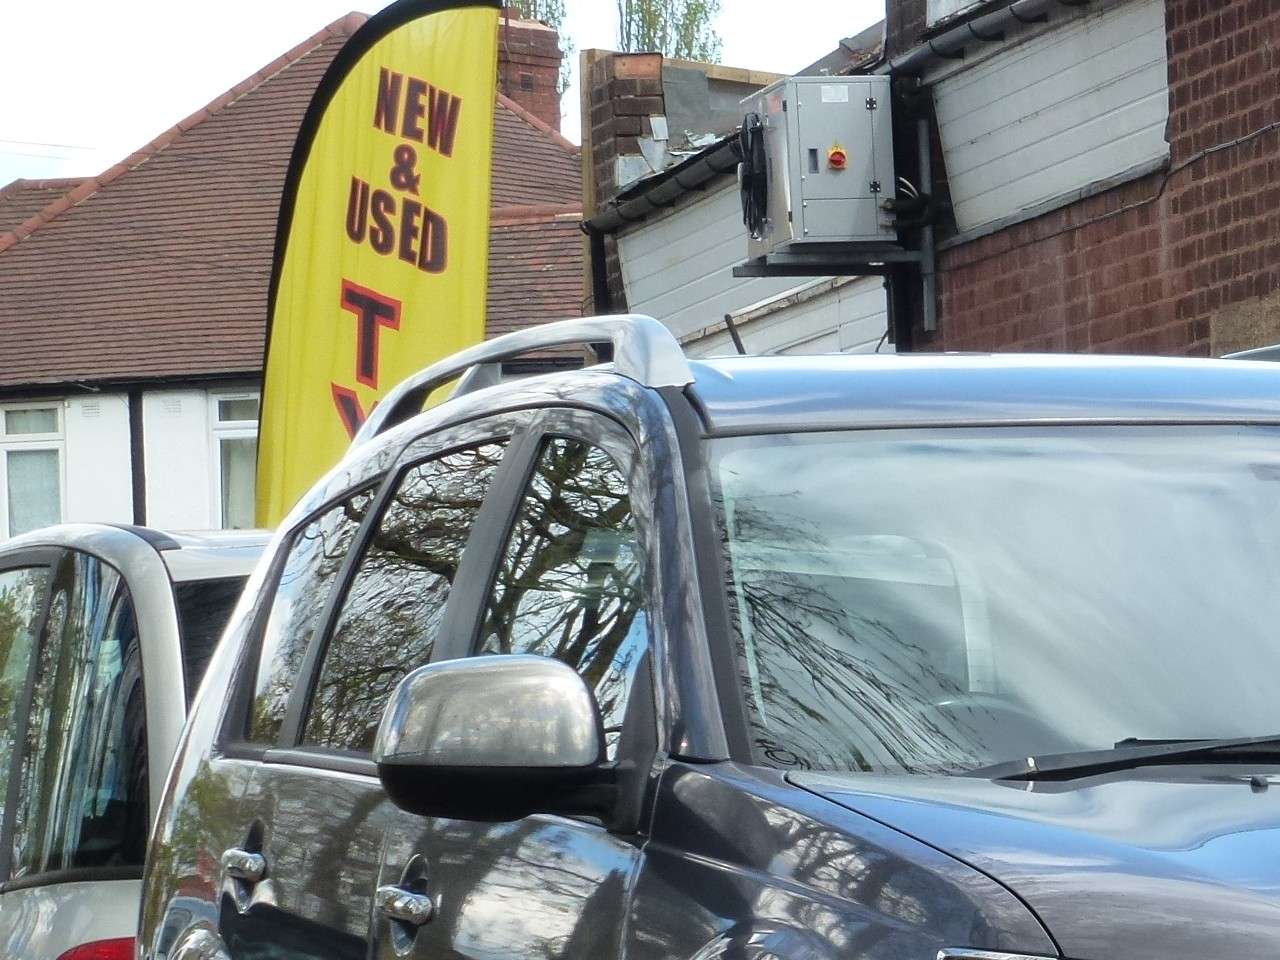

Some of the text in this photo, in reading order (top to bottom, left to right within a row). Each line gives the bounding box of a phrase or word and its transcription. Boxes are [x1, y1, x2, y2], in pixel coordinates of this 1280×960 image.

[373, 66, 463, 158] NEW
[390, 143, 420, 197] &
[346, 175, 448, 275] USED
